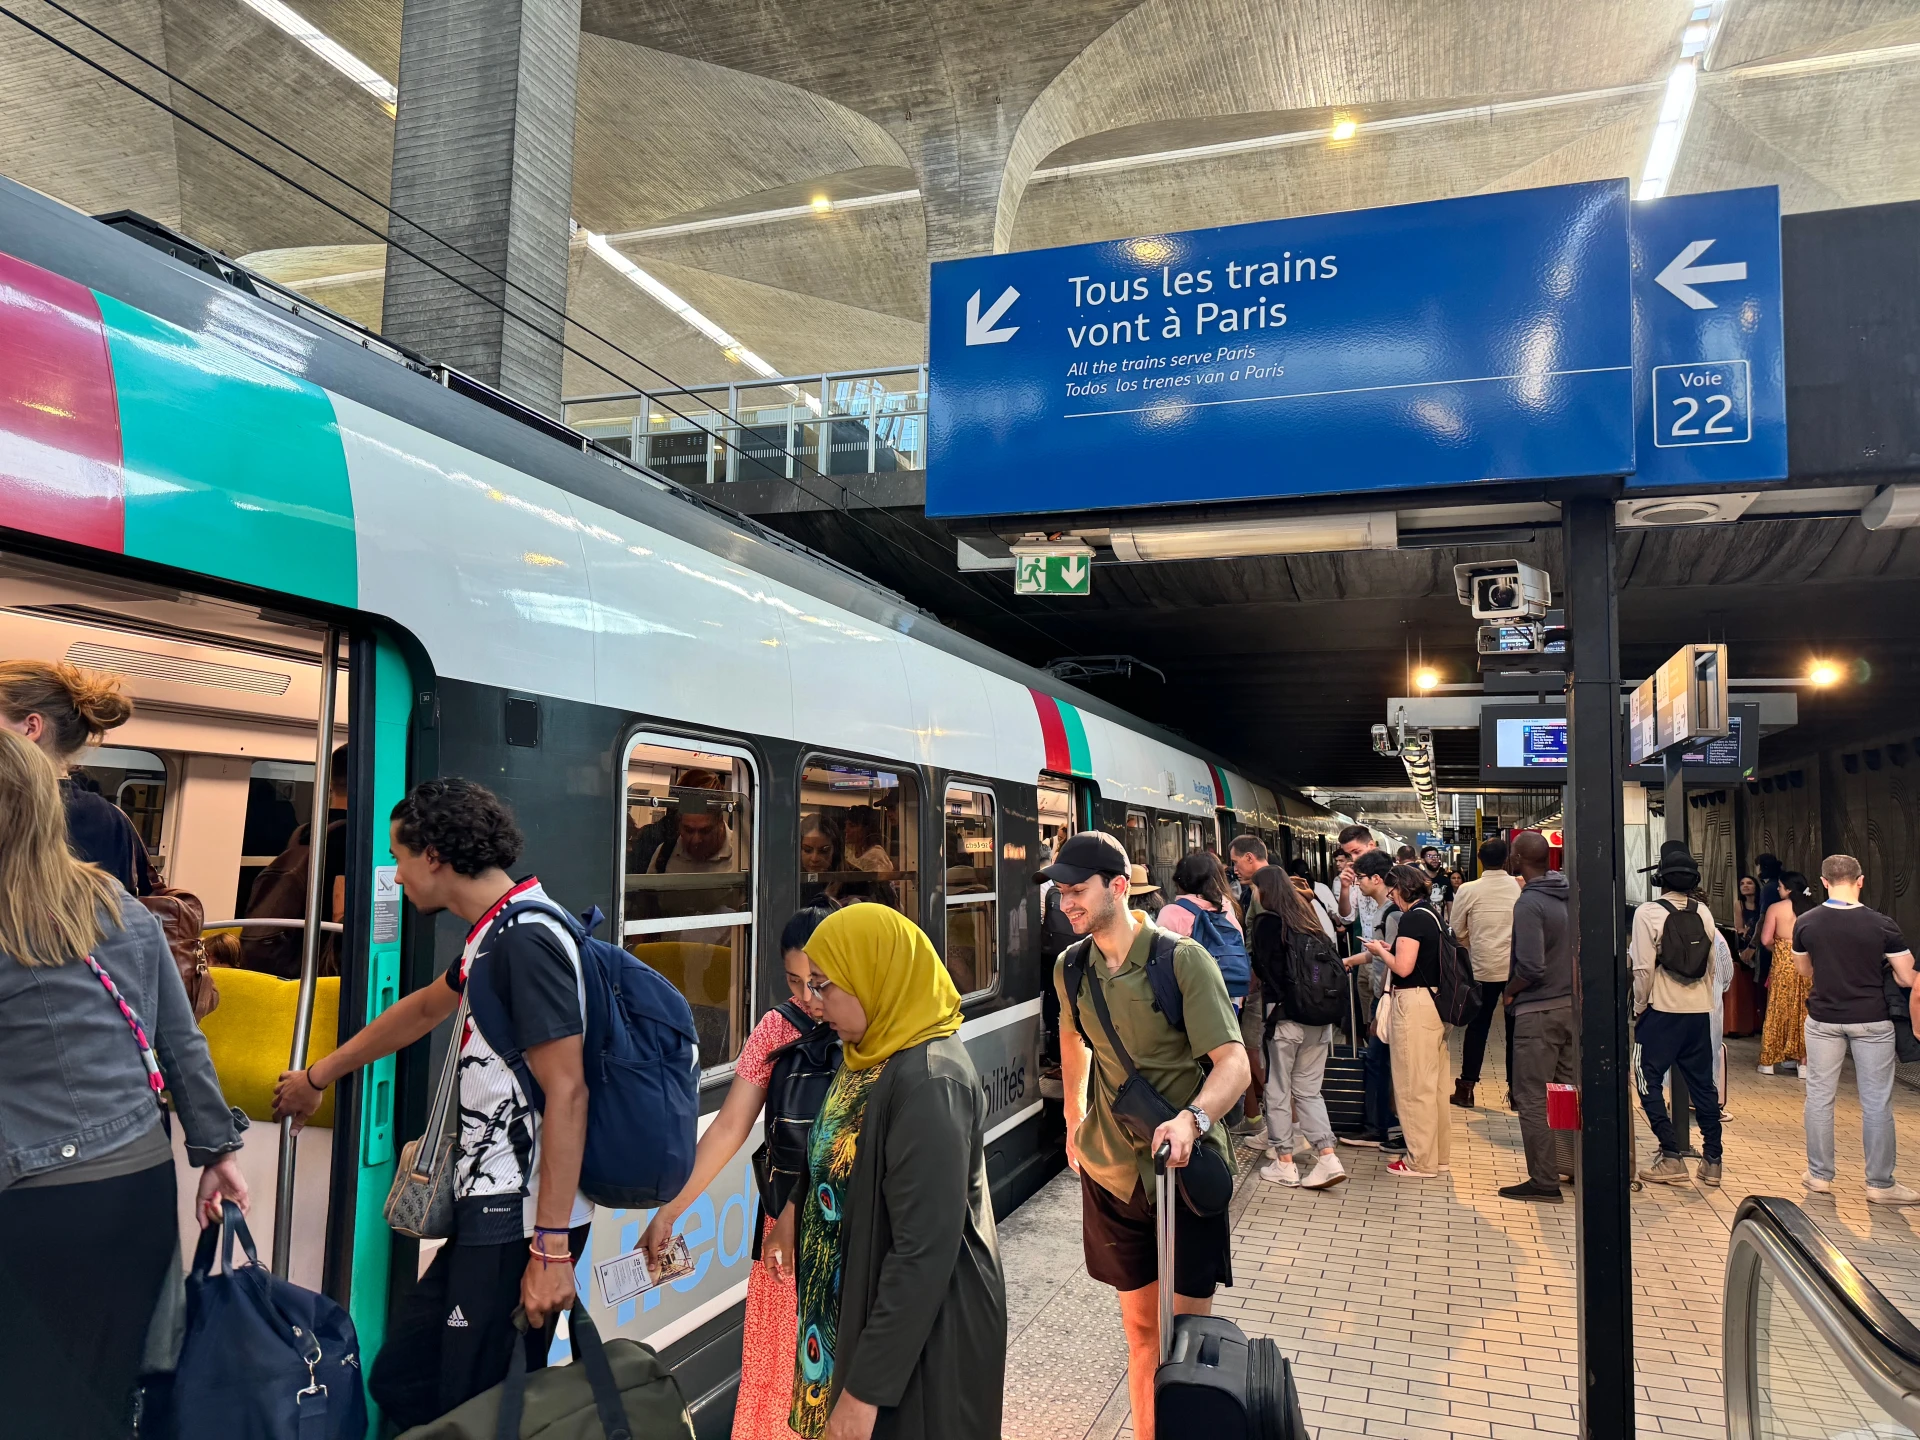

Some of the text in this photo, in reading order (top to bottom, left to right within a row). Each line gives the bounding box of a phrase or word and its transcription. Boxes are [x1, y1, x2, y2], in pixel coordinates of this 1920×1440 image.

[1068, 251, 1338, 308] Tous les trains
[1067, 296, 1287, 349] vont à Paris
[1066, 346, 1256, 377] All the trains serve Paris
[1065, 362, 1285, 397] Todos los trenes van a Paris
[1679, 371, 1722, 388] Voie
[1671, 394, 1733, 437] 22
[446, 1318, 469, 1327] adidas
